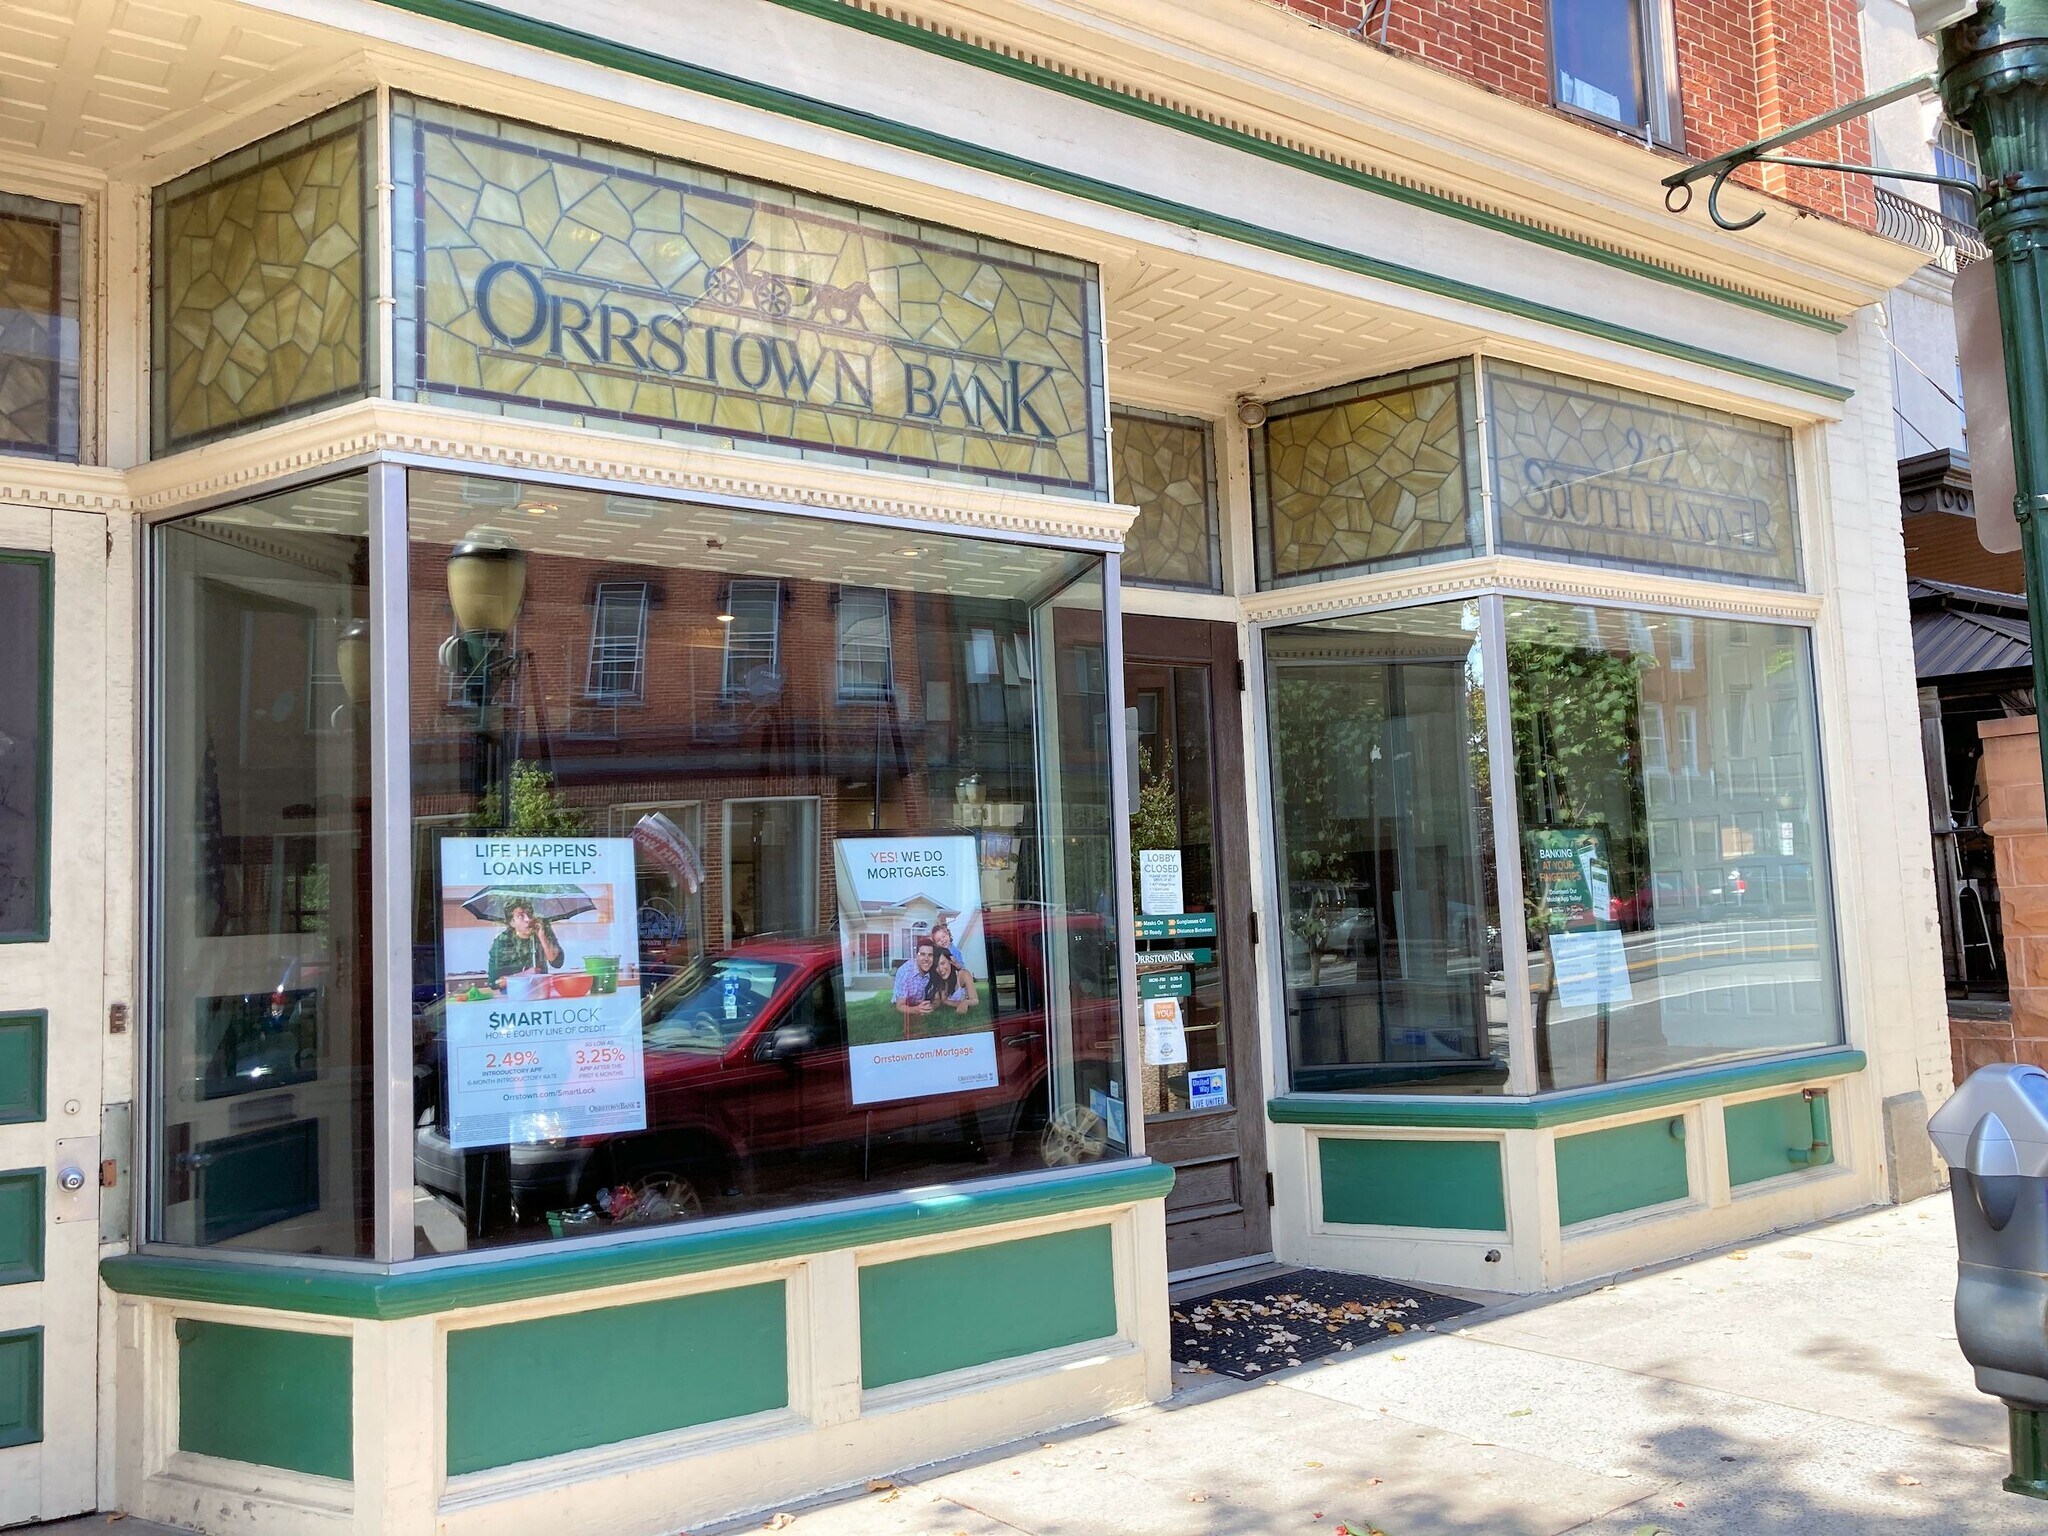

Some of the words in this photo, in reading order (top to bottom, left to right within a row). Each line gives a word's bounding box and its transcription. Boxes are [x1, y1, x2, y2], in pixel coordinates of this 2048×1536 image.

[475, 259, 874, 409] ORRSTOWN
[904, 359, 1060, 439] BANK
[1626, 427, 1679, 485] 22
[1521, 457, 1636, 530] SOUTH
[1649, 494, 1780, 550] HANOVER
[475, 843, 511, 858] LIFE
[516, 843, 602, 858] HAPPENS.
[870, 851, 898, 863] YES!
[900, 851, 920, 862] WE
[924, 850, 943, 862] DO
[1539, 848, 1573, 859] BANKING
[1147, 853, 1176, 863] LOBBY
[483, 861, 544, 876] LOANS
[549, 861, 596, 875] HELP.
[1144, 864, 1179, 874] CLOSED
[1542, 860, 1551, 870] AT
[1552, 860, 1575, 871] YOUR
[867, 865, 949, 880] MORTGAGES.
[1539, 871, 1582, 882] FINGERTIPS
[1176, 918, 1198, 926] Sunglasses
[513, 1029, 544, 1038] EQUITY
[545, 1027, 563, 1036] LINE
[565, 1026, 577, 1034] OF
[578, 1024, 607, 1034] CREDIT
[486, 1050, 540, 1068] 2.49%
[575, 1047, 626, 1065] 3.25%
[873, 1046, 974, 1065] Orrstown.com/Mortgage
[482, 1067, 532, 1077] INTRODUCTORY
[1192, 1077, 1209, 1087] United
[502, 1087, 596, 1101] Orrstown.com/SmartLock
[1192, 1099, 1204, 1109] LIVE
[1205, 1096, 1225, 1107] UNITED
